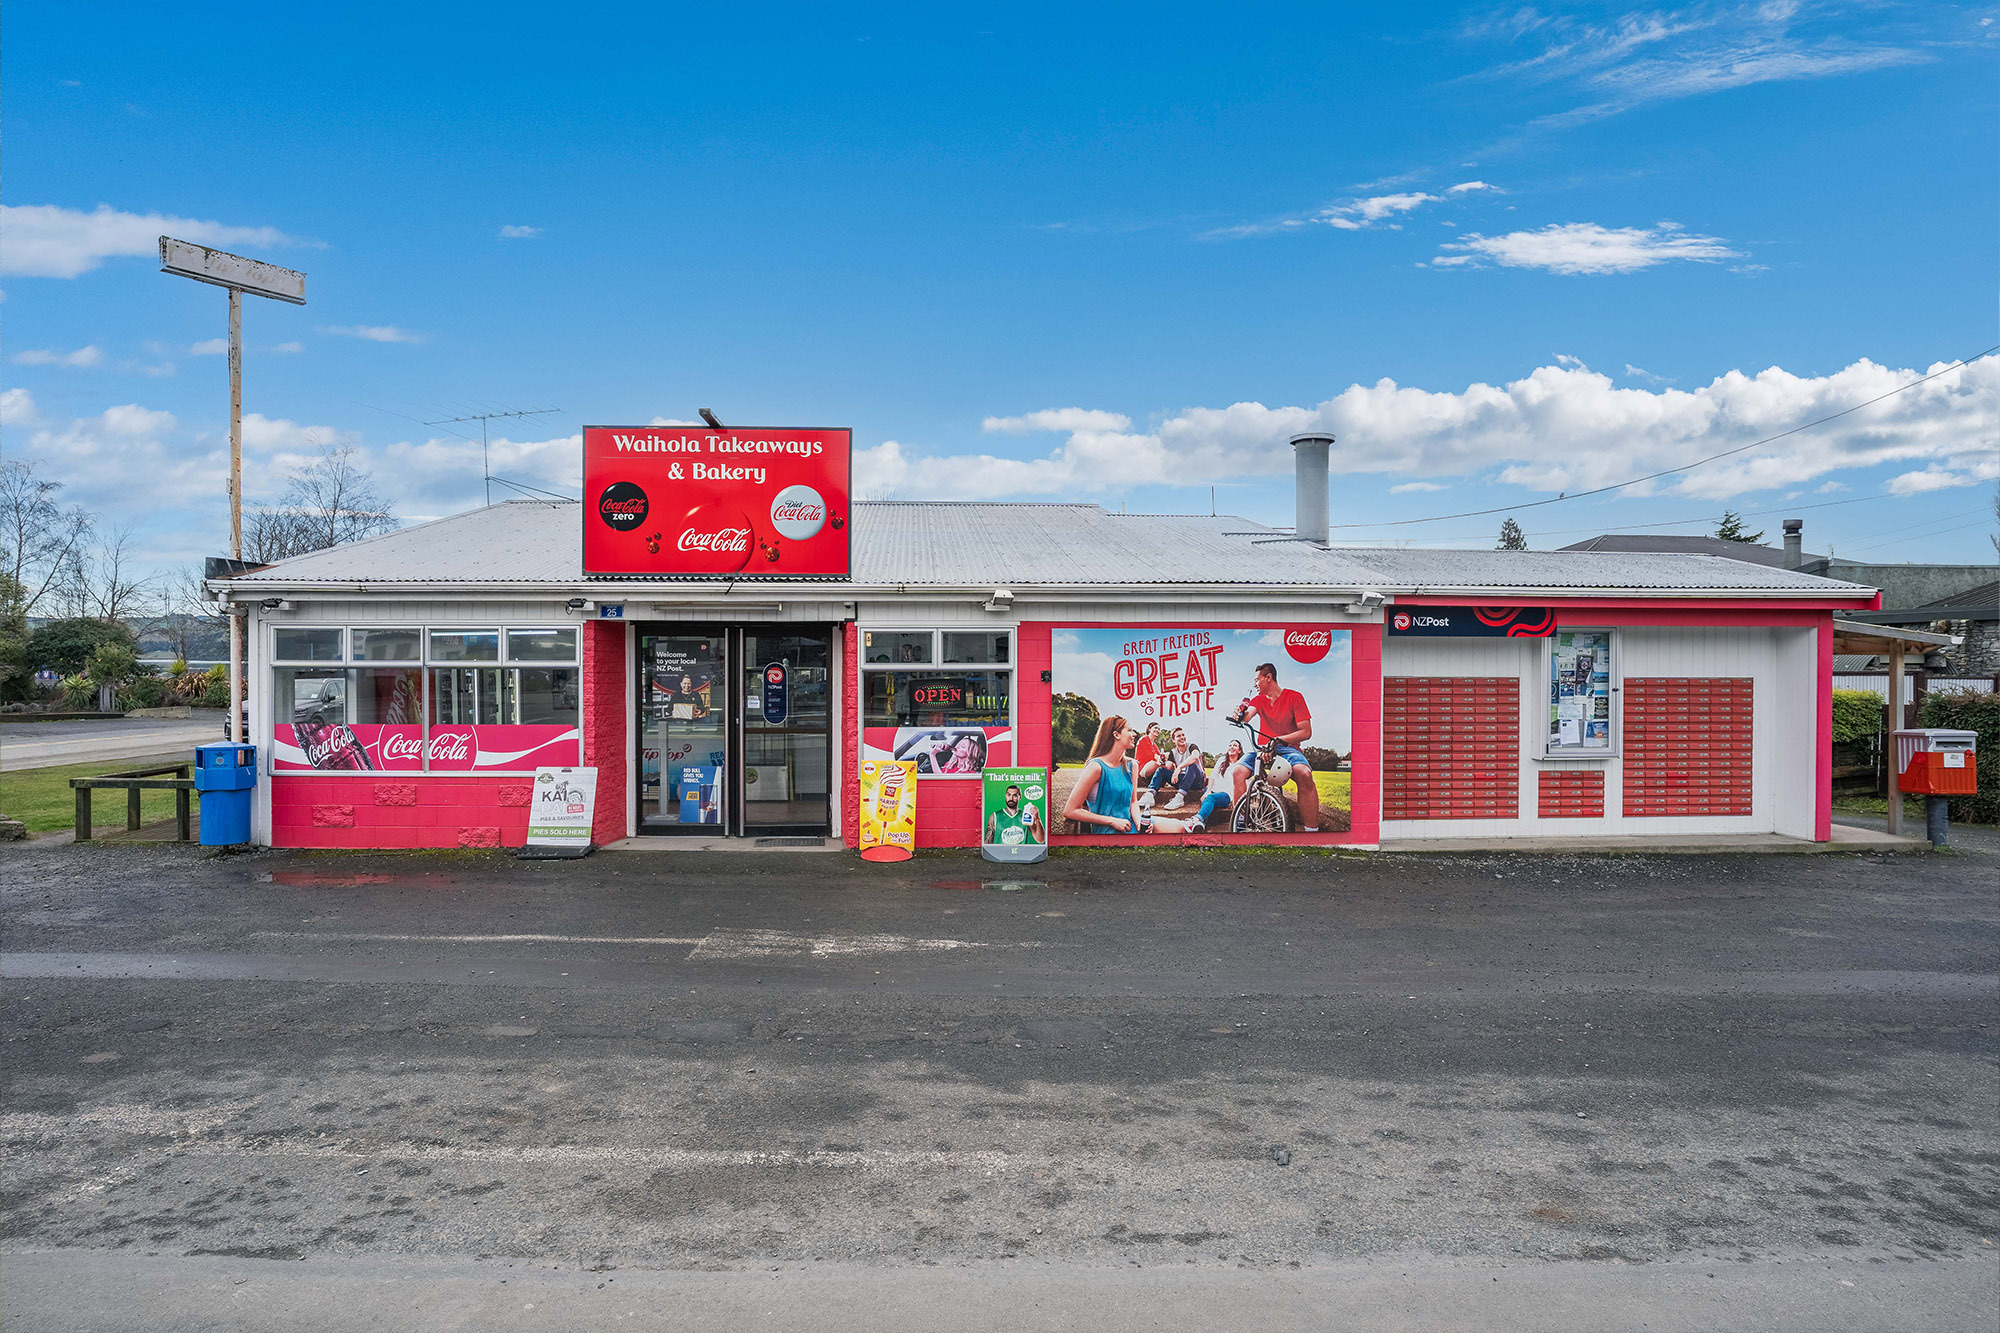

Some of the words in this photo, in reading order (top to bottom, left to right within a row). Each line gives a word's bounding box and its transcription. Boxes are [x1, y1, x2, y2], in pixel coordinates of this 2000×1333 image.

[612, 434, 701, 454] Waihola
[704, 434, 823, 458] Takeaways
[667, 462, 685, 480] &
[692, 462, 766, 484] Bakery
[601, 498, 648, 514] Coca-Cola
[773, 504, 824, 521] Coca-Cola
[784, 500, 802, 508] Diet
[612, 513, 635, 521] zero
[677, 527, 752, 552] Coca-Cola
[606, 608, 617, 617] 25
[1412, 616, 1450, 627] NZPost
[1123, 638, 1158, 656] GREAT
[1162, 632, 1213, 651] FRIENDS.
[1286, 630, 1331, 647] Coca-Cola
[1114, 645, 1224, 701] GREAT
[914, 688, 962, 703] OPEN
[1156, 688, 1215, 717] TASTE
[308, 726, 355, 766] Coca-Cola
[383, 732, 473, 760] Coca-Cola
[1010, 773, 1024, 781] nice
[542, 790, 567, 802] KAI
